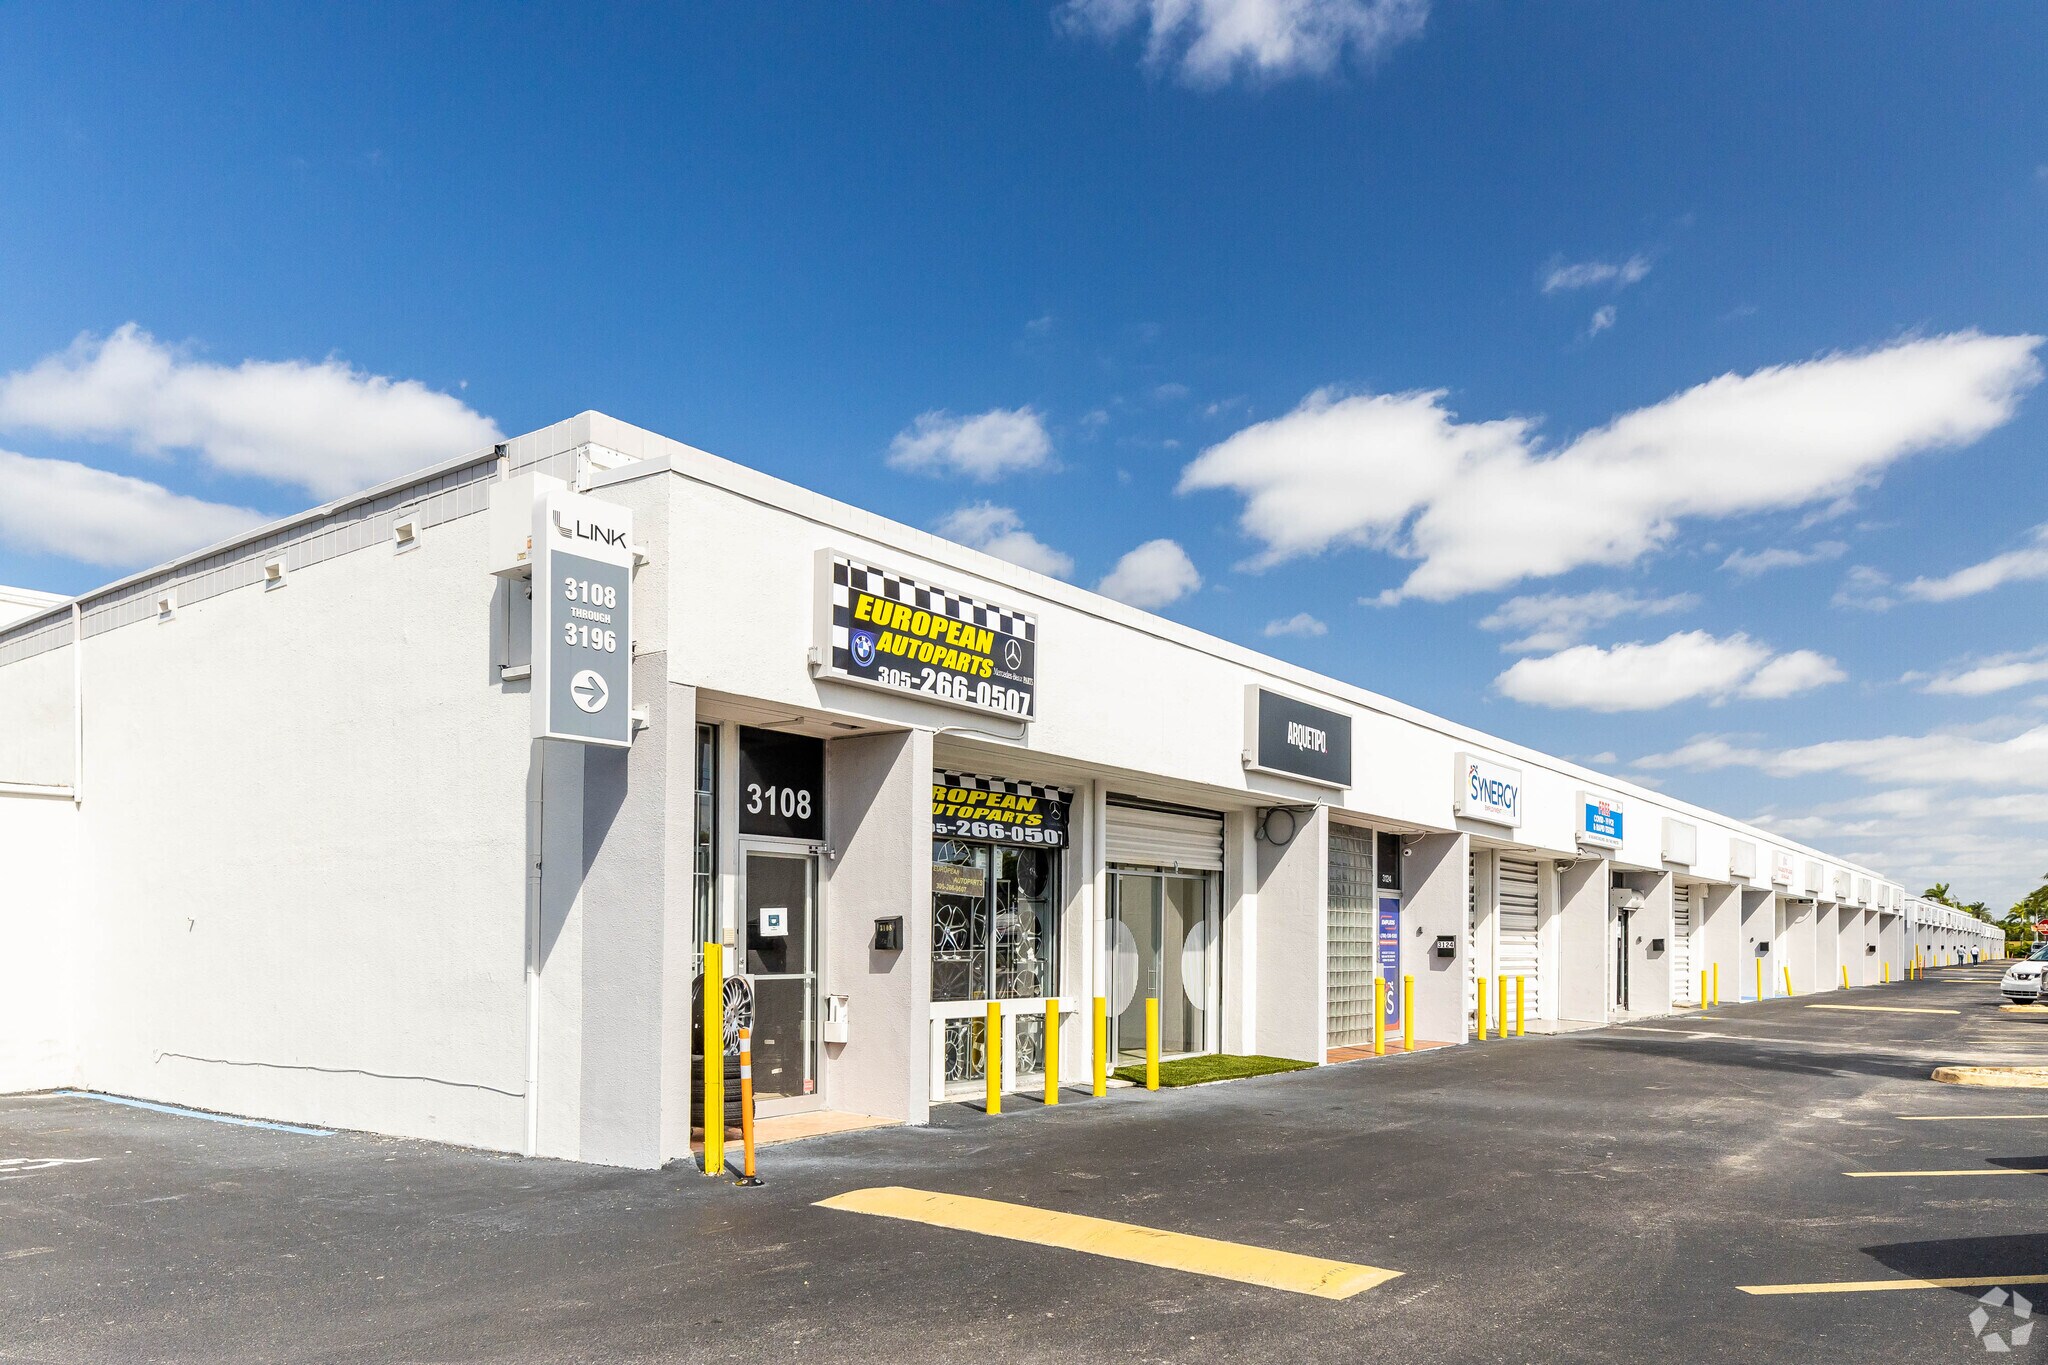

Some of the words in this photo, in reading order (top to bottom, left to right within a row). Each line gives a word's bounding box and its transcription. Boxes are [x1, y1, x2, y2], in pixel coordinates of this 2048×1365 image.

[576, 519, 627, 549] LINK
[564, 577, 616, 609] 3108
[571, 607, 611, 624] THROUGH
[854, 593, 995, 655] EUROPEAN
[564, 622, 616, 653] 3196
[875, 631, 994, 678] AUTOPARTS
[878, 666, 1031, 716] 305-266-0507
[746, 783, 812, 820] 3108
[932, 785, 1038, 812] ROPEAN
[1470, 774, 1518, 817] SYNERGY
[932, 802, 1044, 826] UTOPARTS
[1437, 940, 1454, 949] 3124
